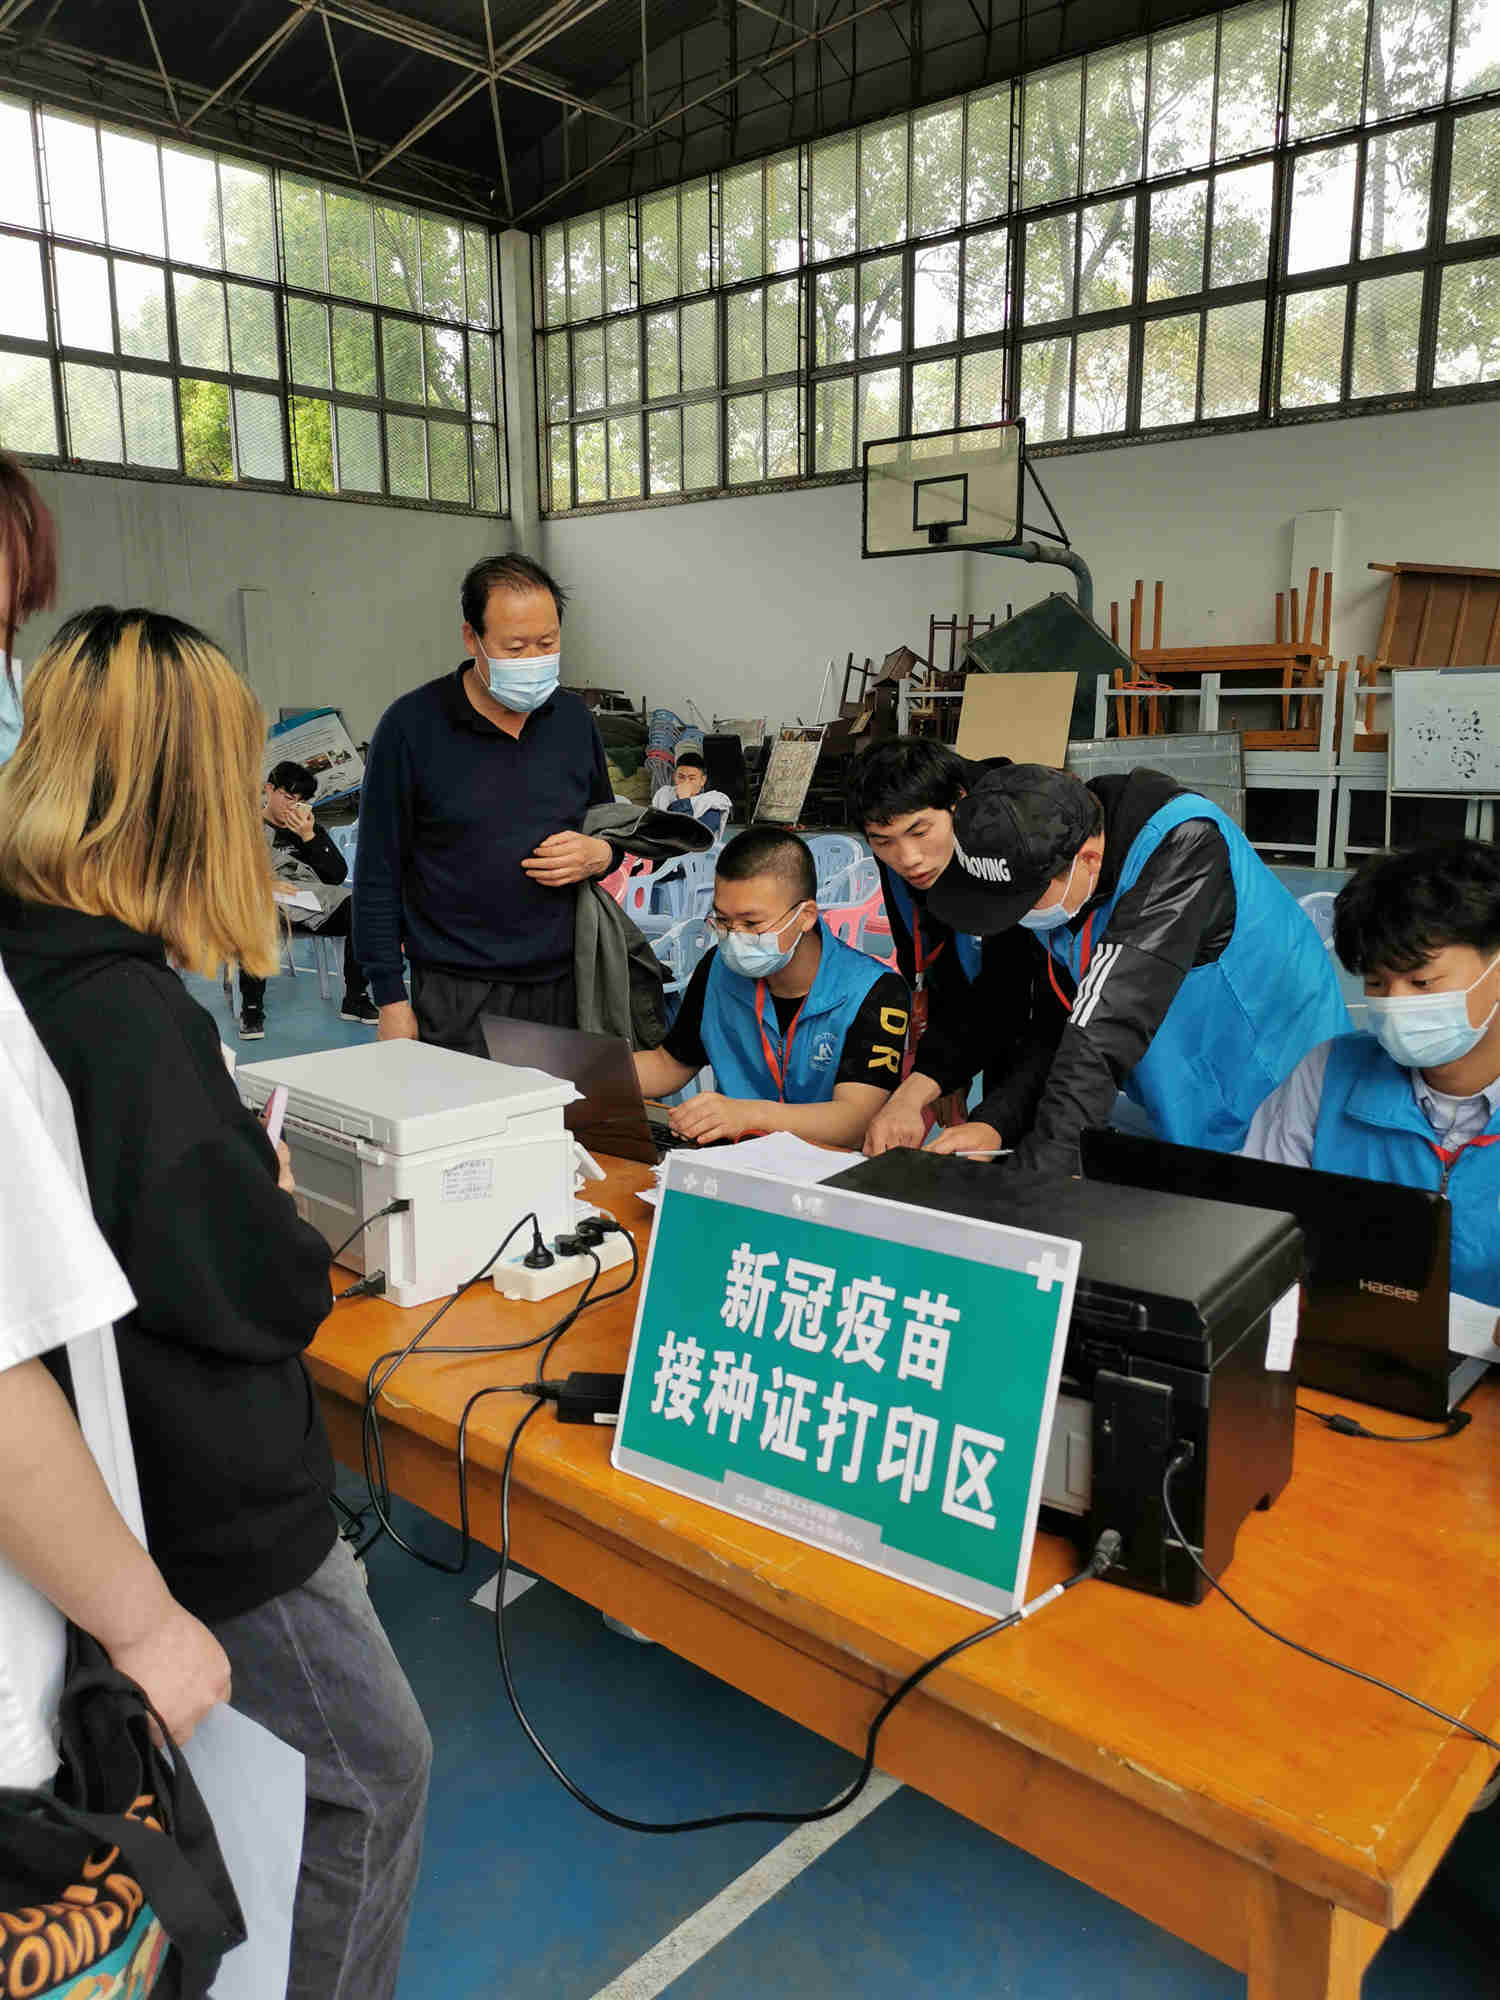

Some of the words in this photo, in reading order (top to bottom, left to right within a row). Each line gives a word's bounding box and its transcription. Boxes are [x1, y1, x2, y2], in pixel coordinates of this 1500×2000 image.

[720, 1242, 961, 1390] 新冠疫苗
[651, 1329, 1006, 1530] 接种证打印区
